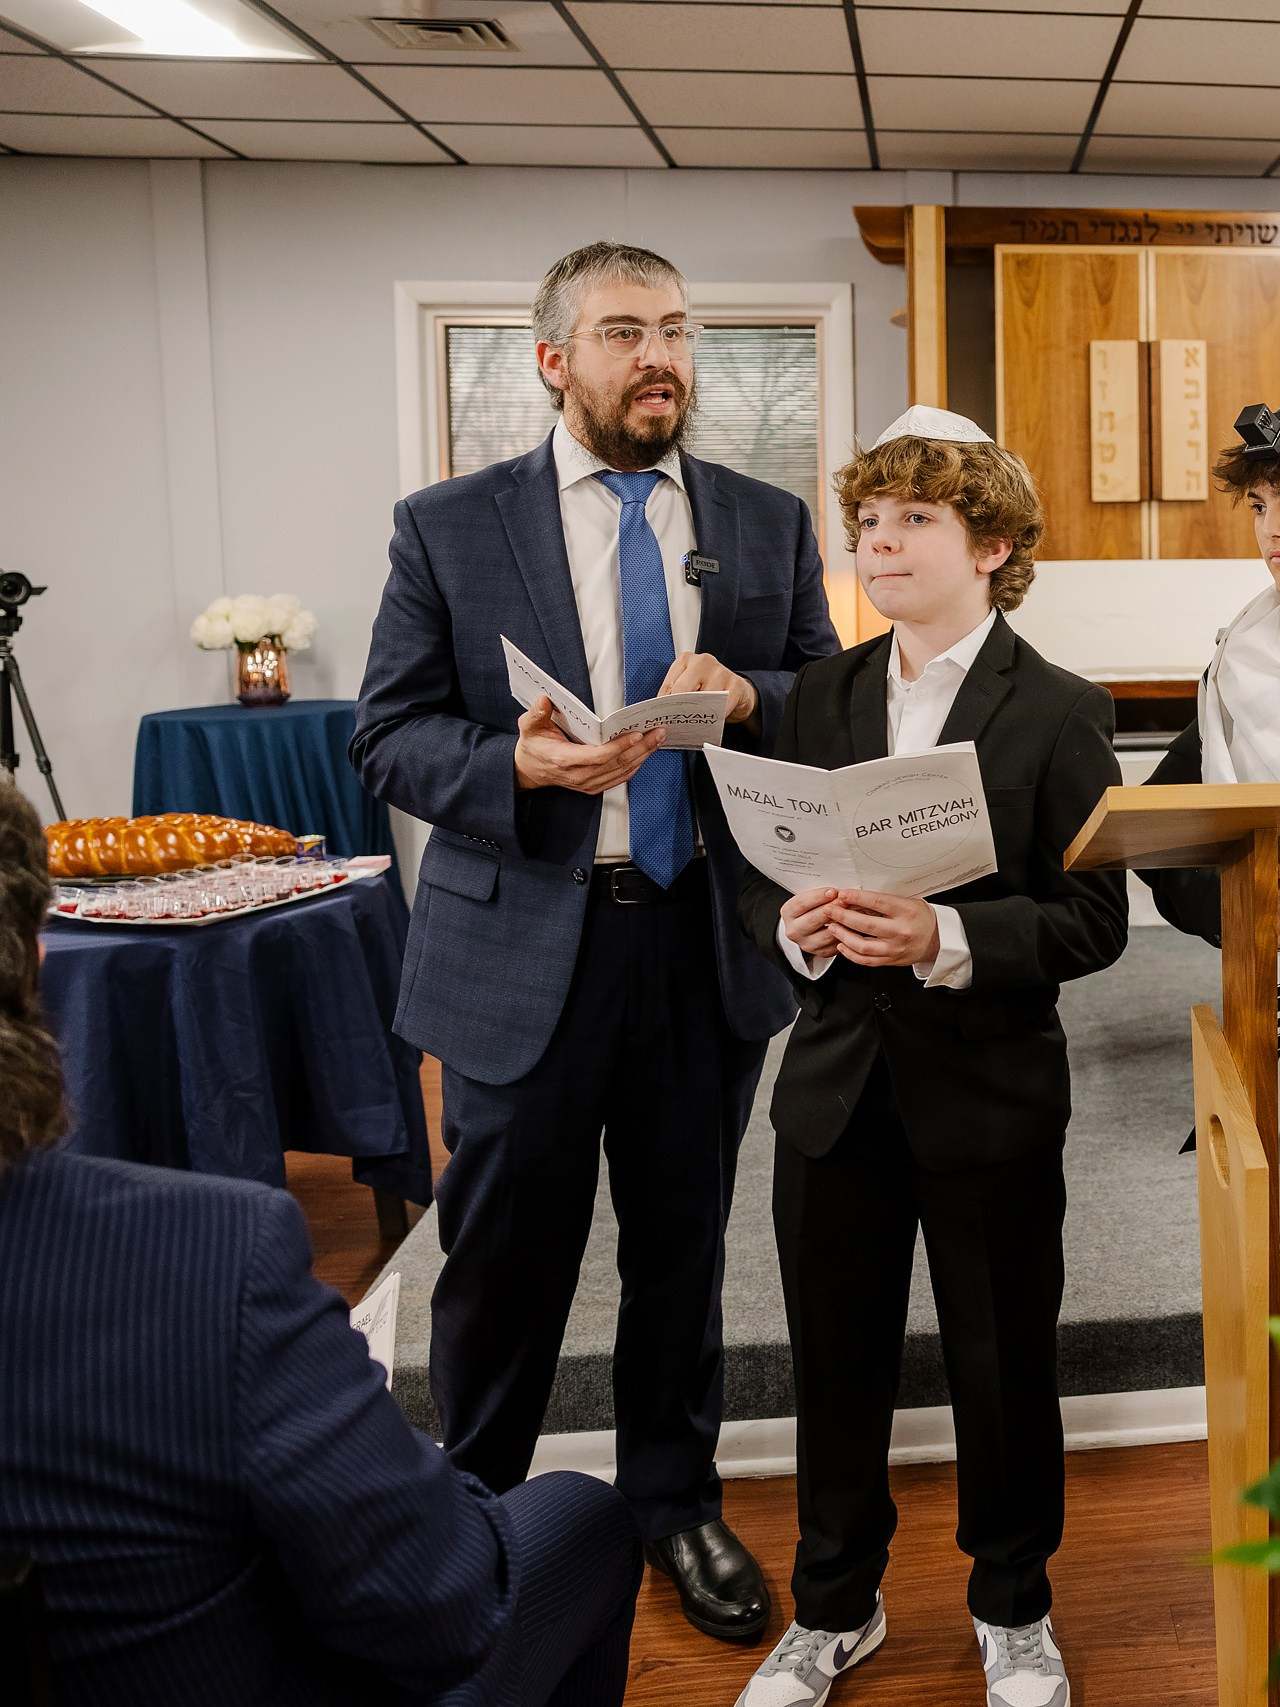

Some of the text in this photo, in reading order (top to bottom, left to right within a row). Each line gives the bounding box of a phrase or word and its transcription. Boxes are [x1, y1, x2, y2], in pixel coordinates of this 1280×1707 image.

[1009, 219, 1079, 242] תמיד
[645, 713, 715, 725] MITZVAH
[727, 783, 784, 809] MAZAL
[787, 798, 828, 816] TOV!
[855, 797, 975, 838] BAR MITZVAH
[900, 808, 980, 839] CEREMONY
